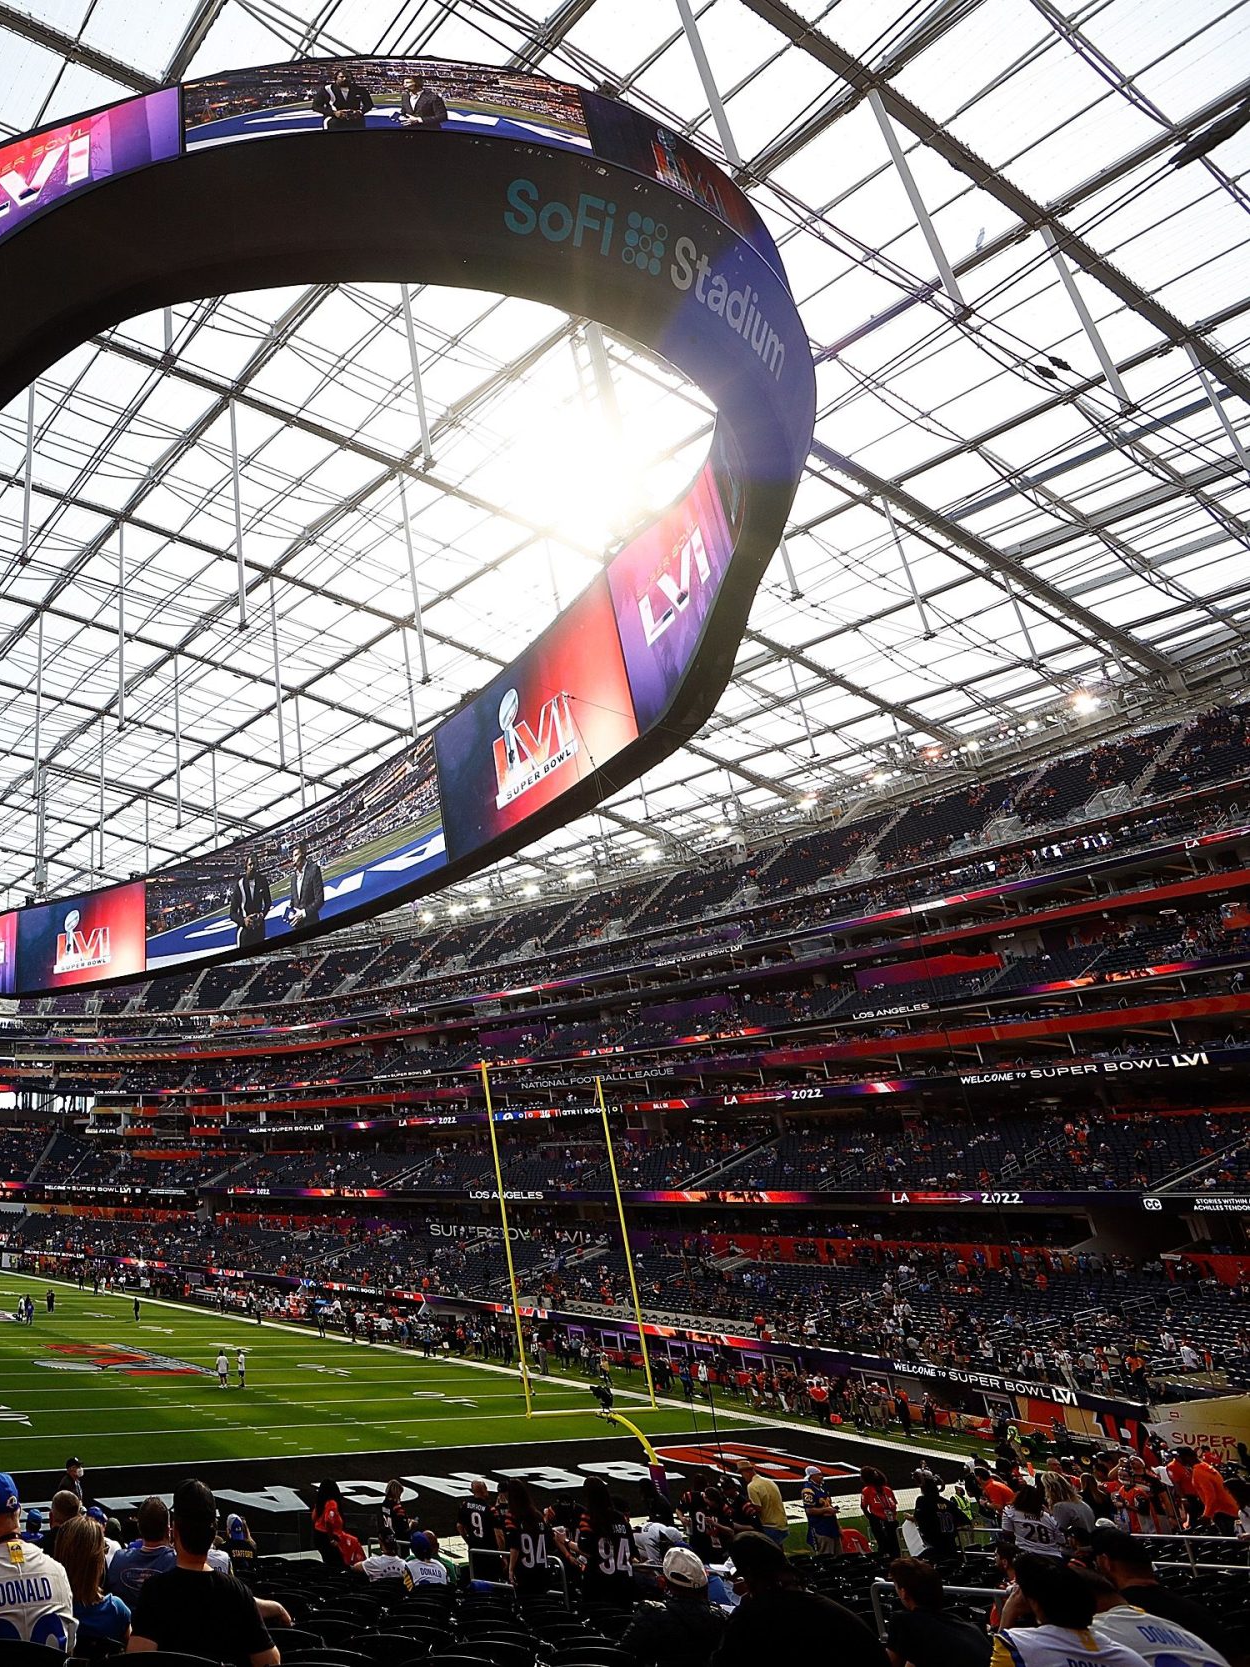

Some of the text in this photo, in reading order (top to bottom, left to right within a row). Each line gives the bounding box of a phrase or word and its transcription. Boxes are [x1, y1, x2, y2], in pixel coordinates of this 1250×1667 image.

[504, 177, 787, 381] SoFi Stadium
[637, 525, 711, 648] LVI
[506, 749, 572, 800] SUPER BOWL
[1185, 839, 1200, 849] LA
[87, 958, 107, 967] BOWL
[852, 1003, 930, 1020] LOS ANGELES
[521, 1067, 675, 1090] NATIONAL FOOTBALL LEAGUE
[960, 1071, 1014, 1085] WELCOME
[1030, 1064, 1098, 1079] SUPER
[1104, 1057, 1170, 1072] BOWL
[1171, 1052, 1210, 1068] LVI
[723, 1088, 824, 1105] LA 2022
[398, 1117, 457, 1127] LA 2022
[470, 1191, 543, 1200] LOS ANGELES
[892, 1193, 1023, 1204] LA 2022
[893, 1362, 937, 1377] WELCOME
[949, 1371, 1001, 1390] SUPER
[1005, 1380, 1051, 1398] BOWL
[1051, 1388, 1078, 1406] LVI
[1171, 1431, 1239, 1449] SUPER
[470, 1512, 484, 1538] 9
[1022, 1522, 1050, 1544] 28
[520, 1533, 549, 1570] 94
[598, 1537, 634, 1577] 94
[419, 1566, 443, 1579] DONALD
[1137, 1625, 1204, 1652] DONALD
